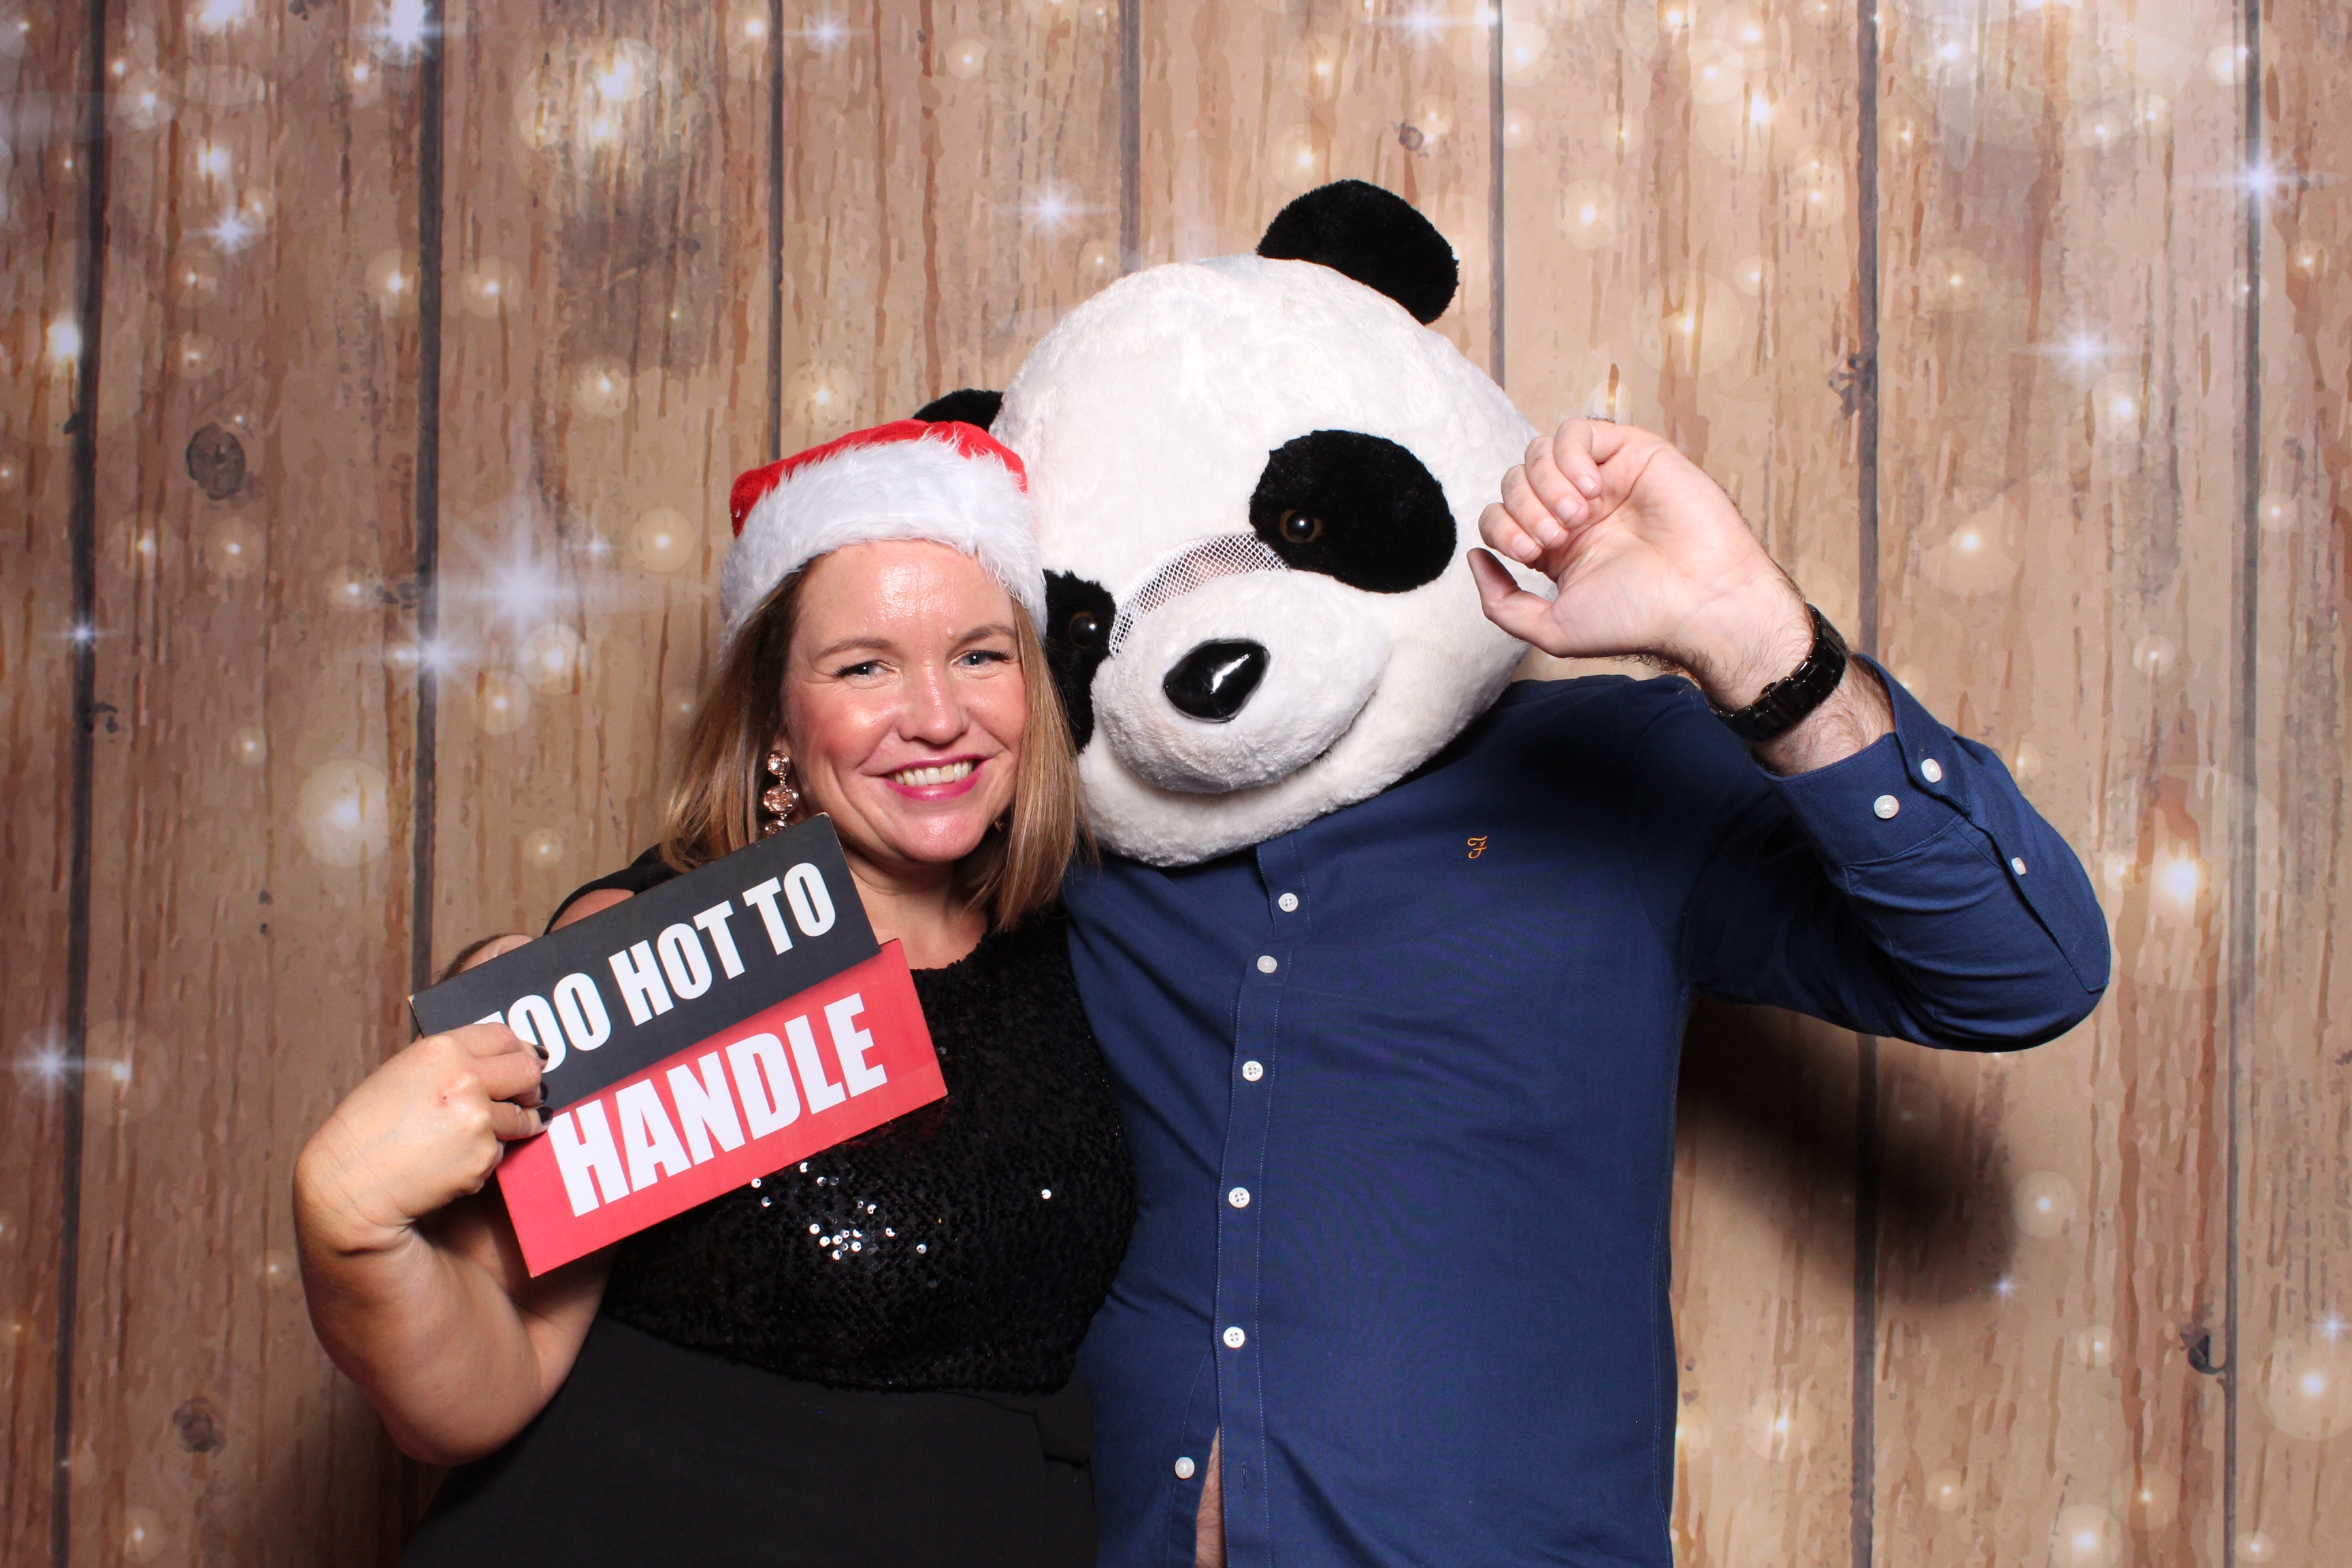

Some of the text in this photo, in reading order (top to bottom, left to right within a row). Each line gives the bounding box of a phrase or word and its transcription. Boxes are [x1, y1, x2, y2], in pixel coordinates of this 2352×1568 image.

[472, 862, 836, 1074] OO HOT TO
[548, 992, 887, 1217] HANDLE
